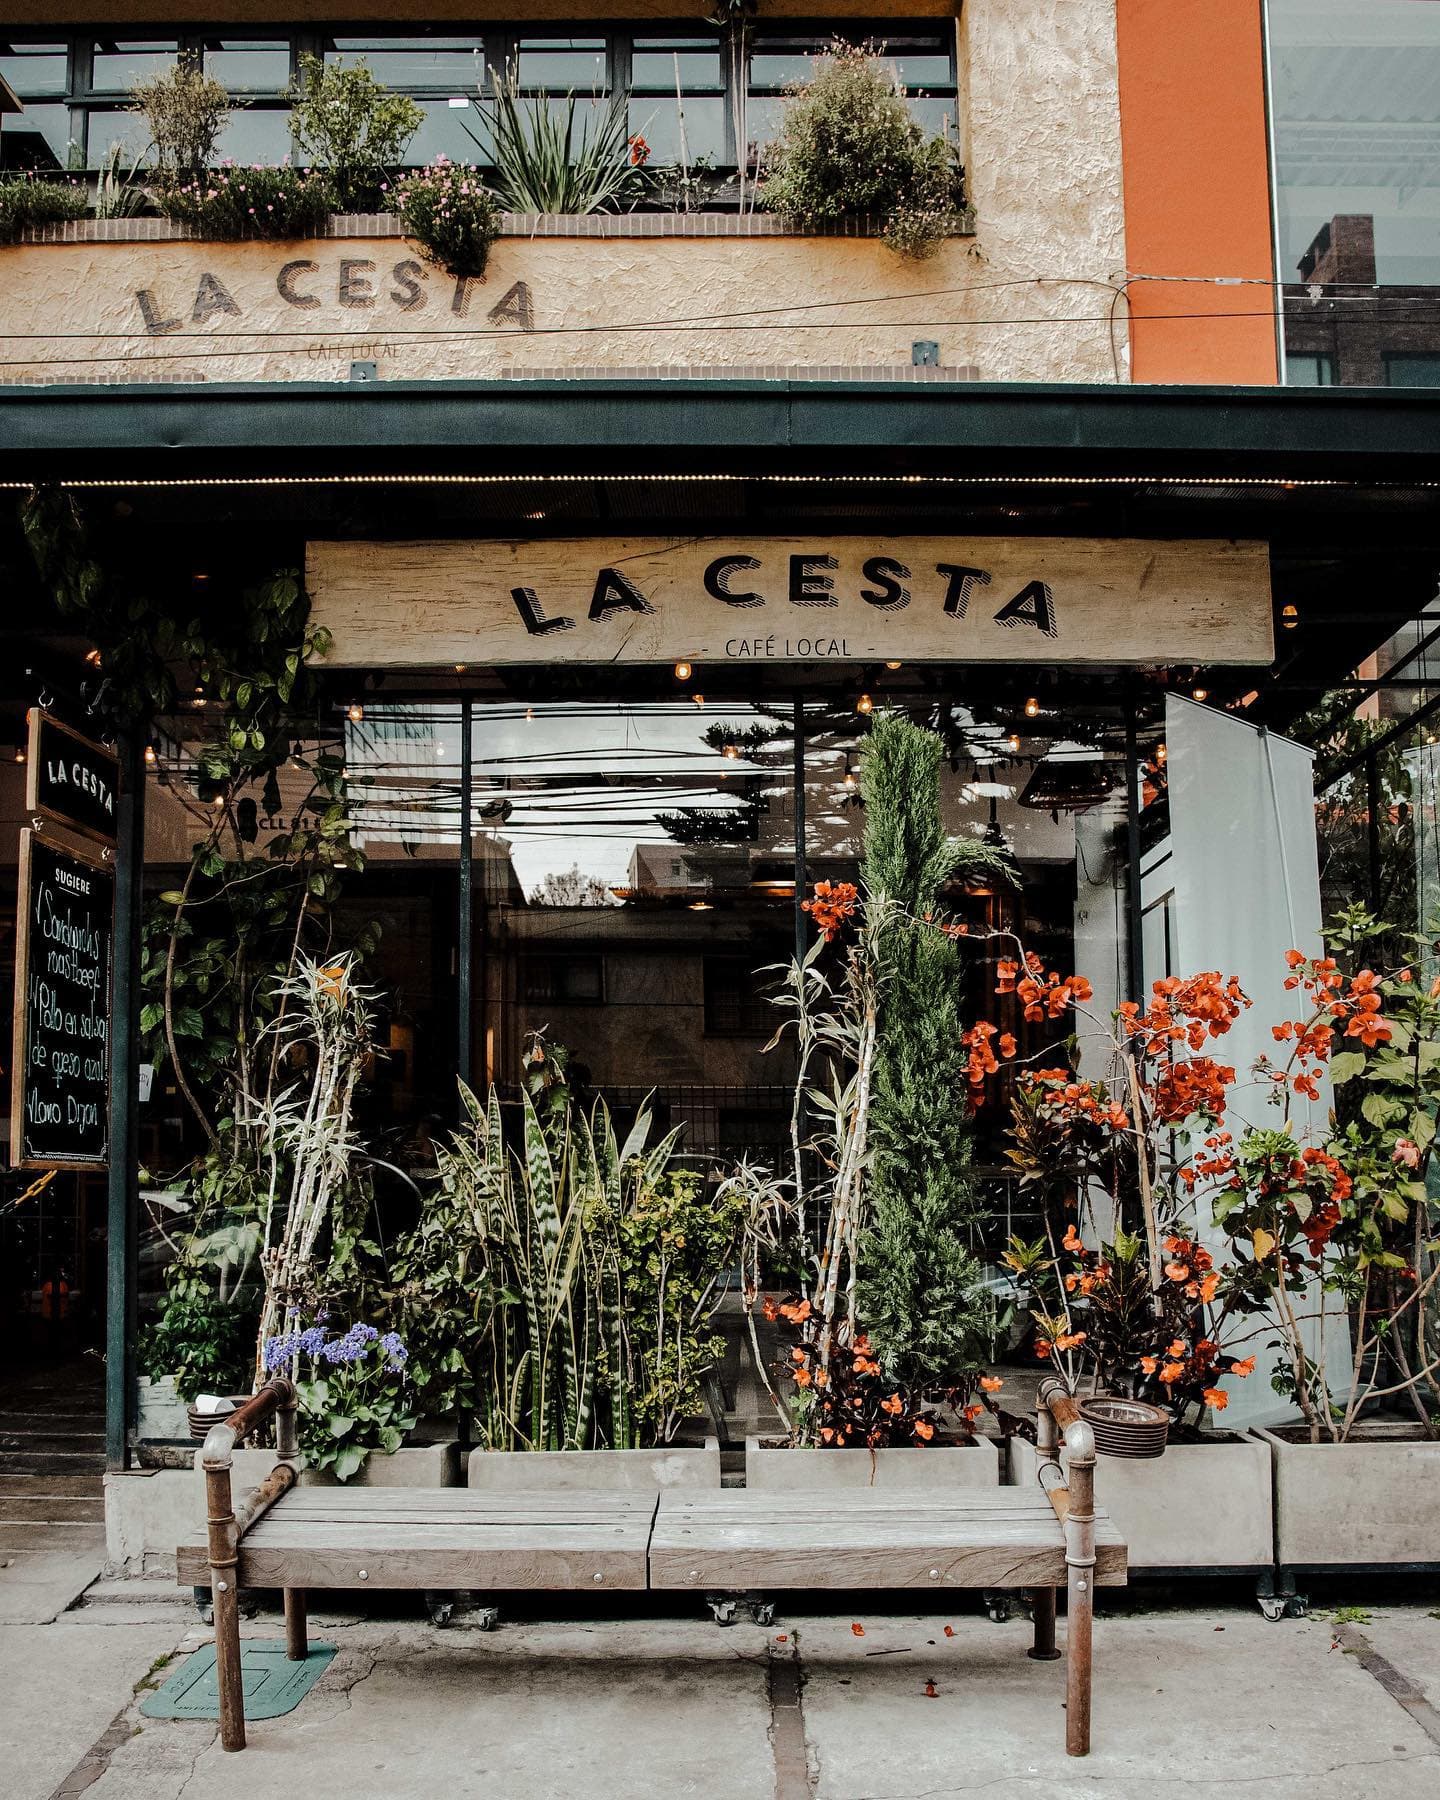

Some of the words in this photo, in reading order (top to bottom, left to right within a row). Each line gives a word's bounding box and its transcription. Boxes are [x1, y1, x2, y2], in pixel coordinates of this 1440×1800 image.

[136, 273, 243, 334] LA
[276, 259, 535, 331] CESTA
[352, 341, 401, 360] LOCAL
[510, 567, 657, 637] LA
[703, 554, 1058, 639] CESTA
[725, 635, 775, 657] CAFÉ
[786, 638, 852, 657] LOCAL
[48, 760, 68, 784] LA
[72, 763, 113, 816] CESTA
[55, 868, 90, 894] SUGIERE
[65, 1013, 77, 1035] en
[32, 1031, 47, 1067] de
